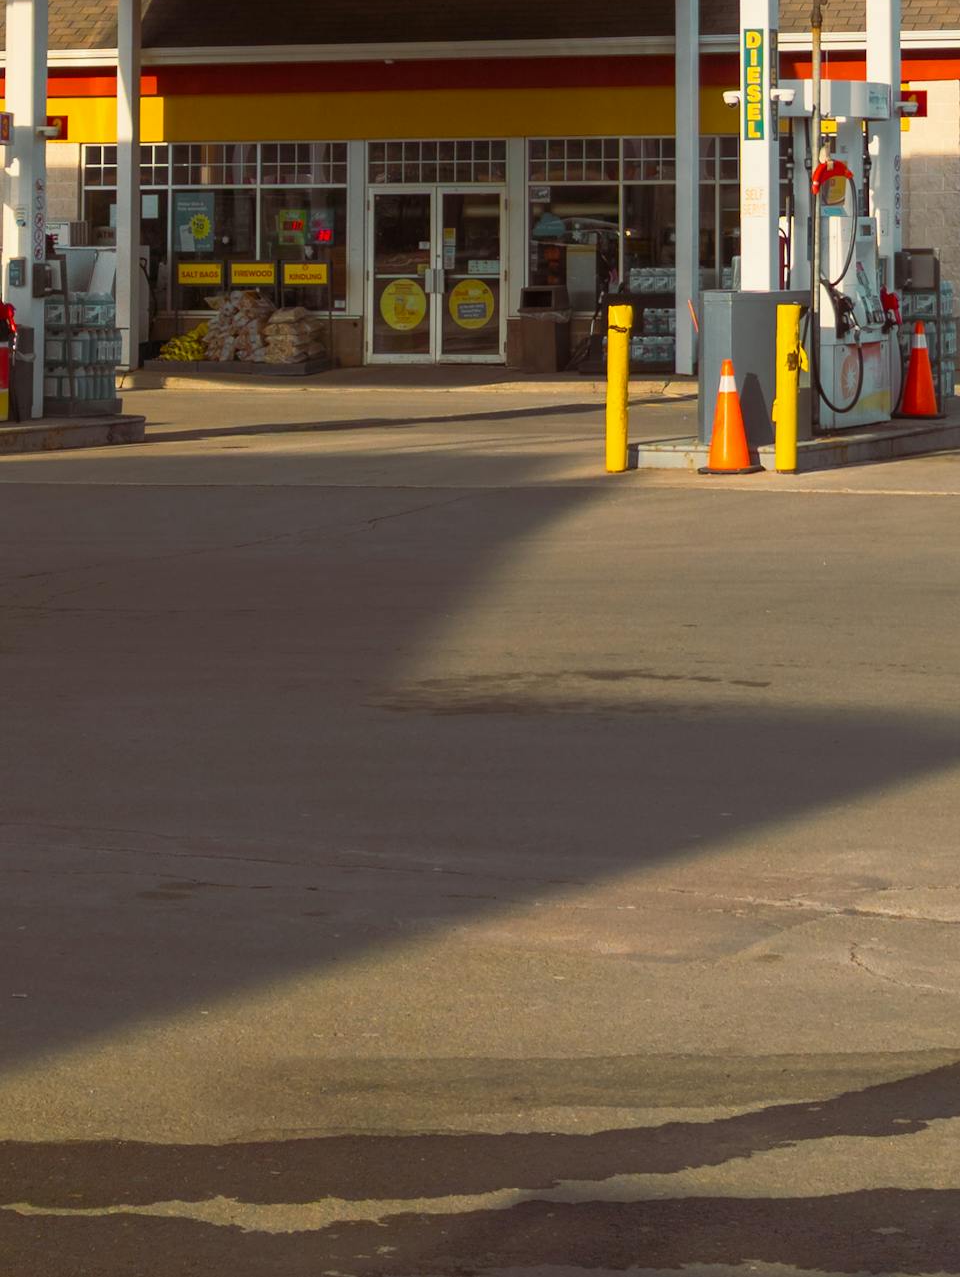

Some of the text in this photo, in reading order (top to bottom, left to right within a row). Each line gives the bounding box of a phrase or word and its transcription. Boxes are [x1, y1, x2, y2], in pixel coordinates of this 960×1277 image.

[745, 31, 761, 138] DIESEL
[199, 270, 219, 278] BAGS
[233, 269, 273, 277] FIREWOOD
[288, 273, 322, 281] KINDLING
